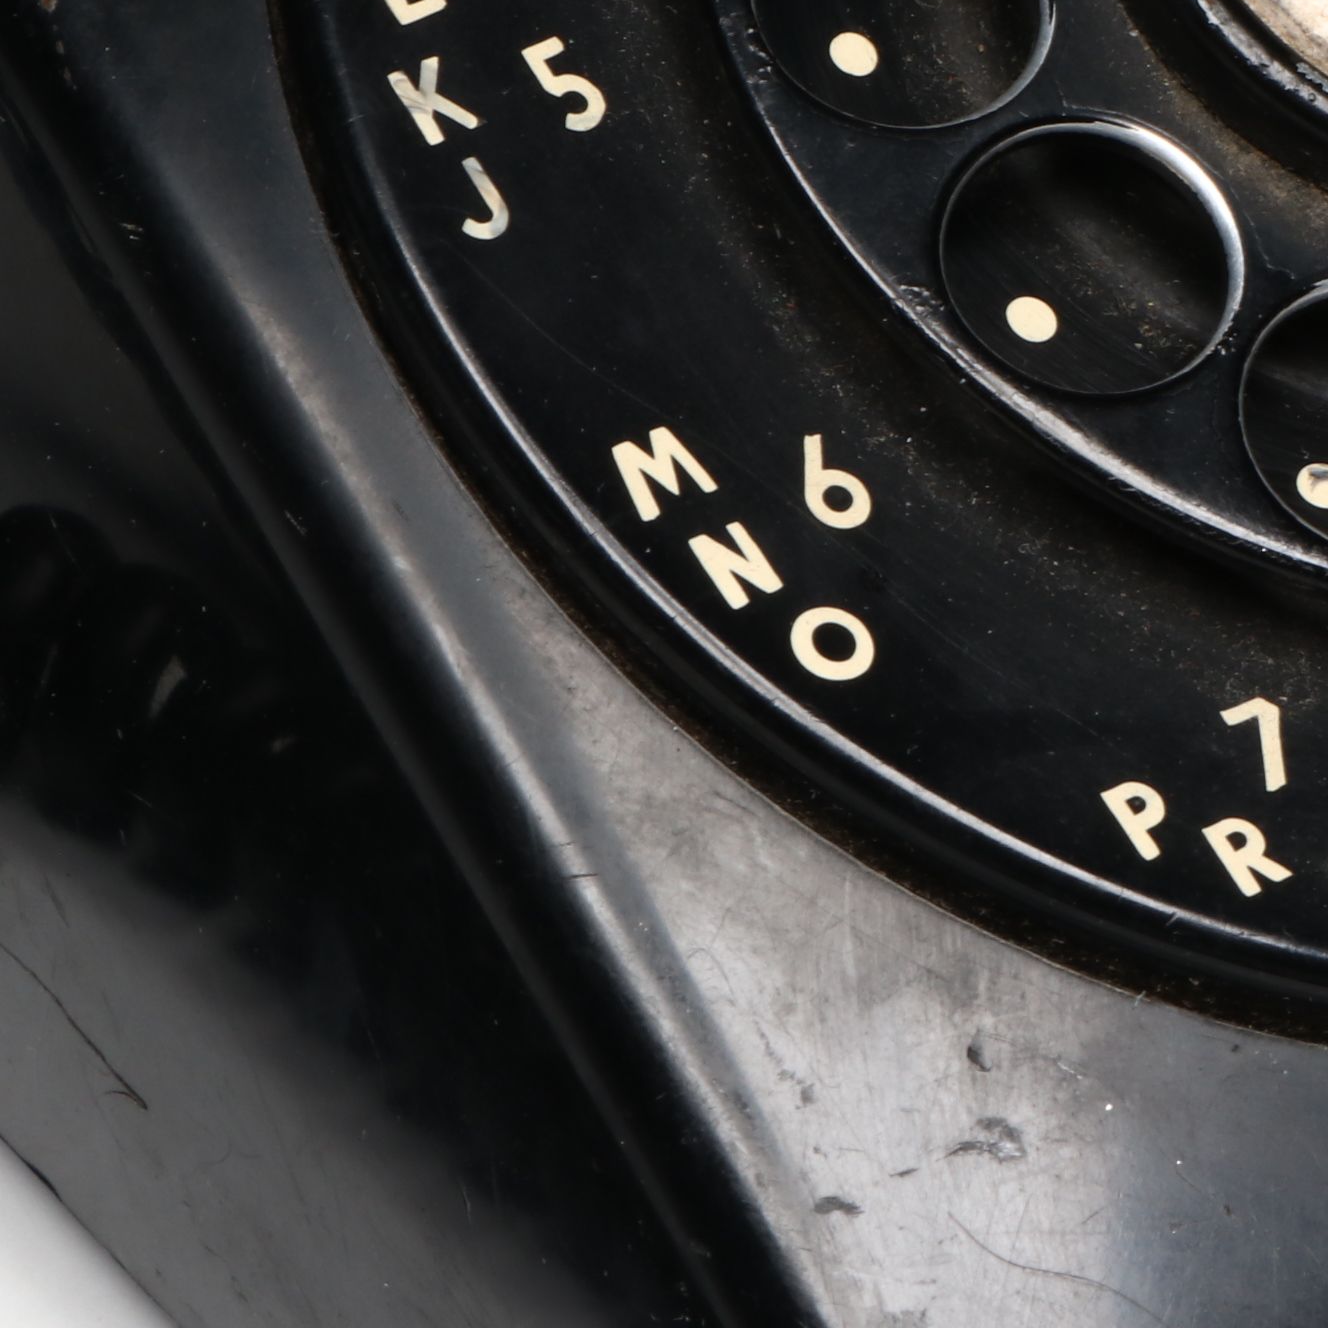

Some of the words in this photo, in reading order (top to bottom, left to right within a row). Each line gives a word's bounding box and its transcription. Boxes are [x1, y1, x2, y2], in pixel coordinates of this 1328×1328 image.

[522, 37, 606, 131] 5
[804, 435, 870, 528] 6
[612, 428, 875, 682] MNO
[1221, 698, 1287, 791] 7
